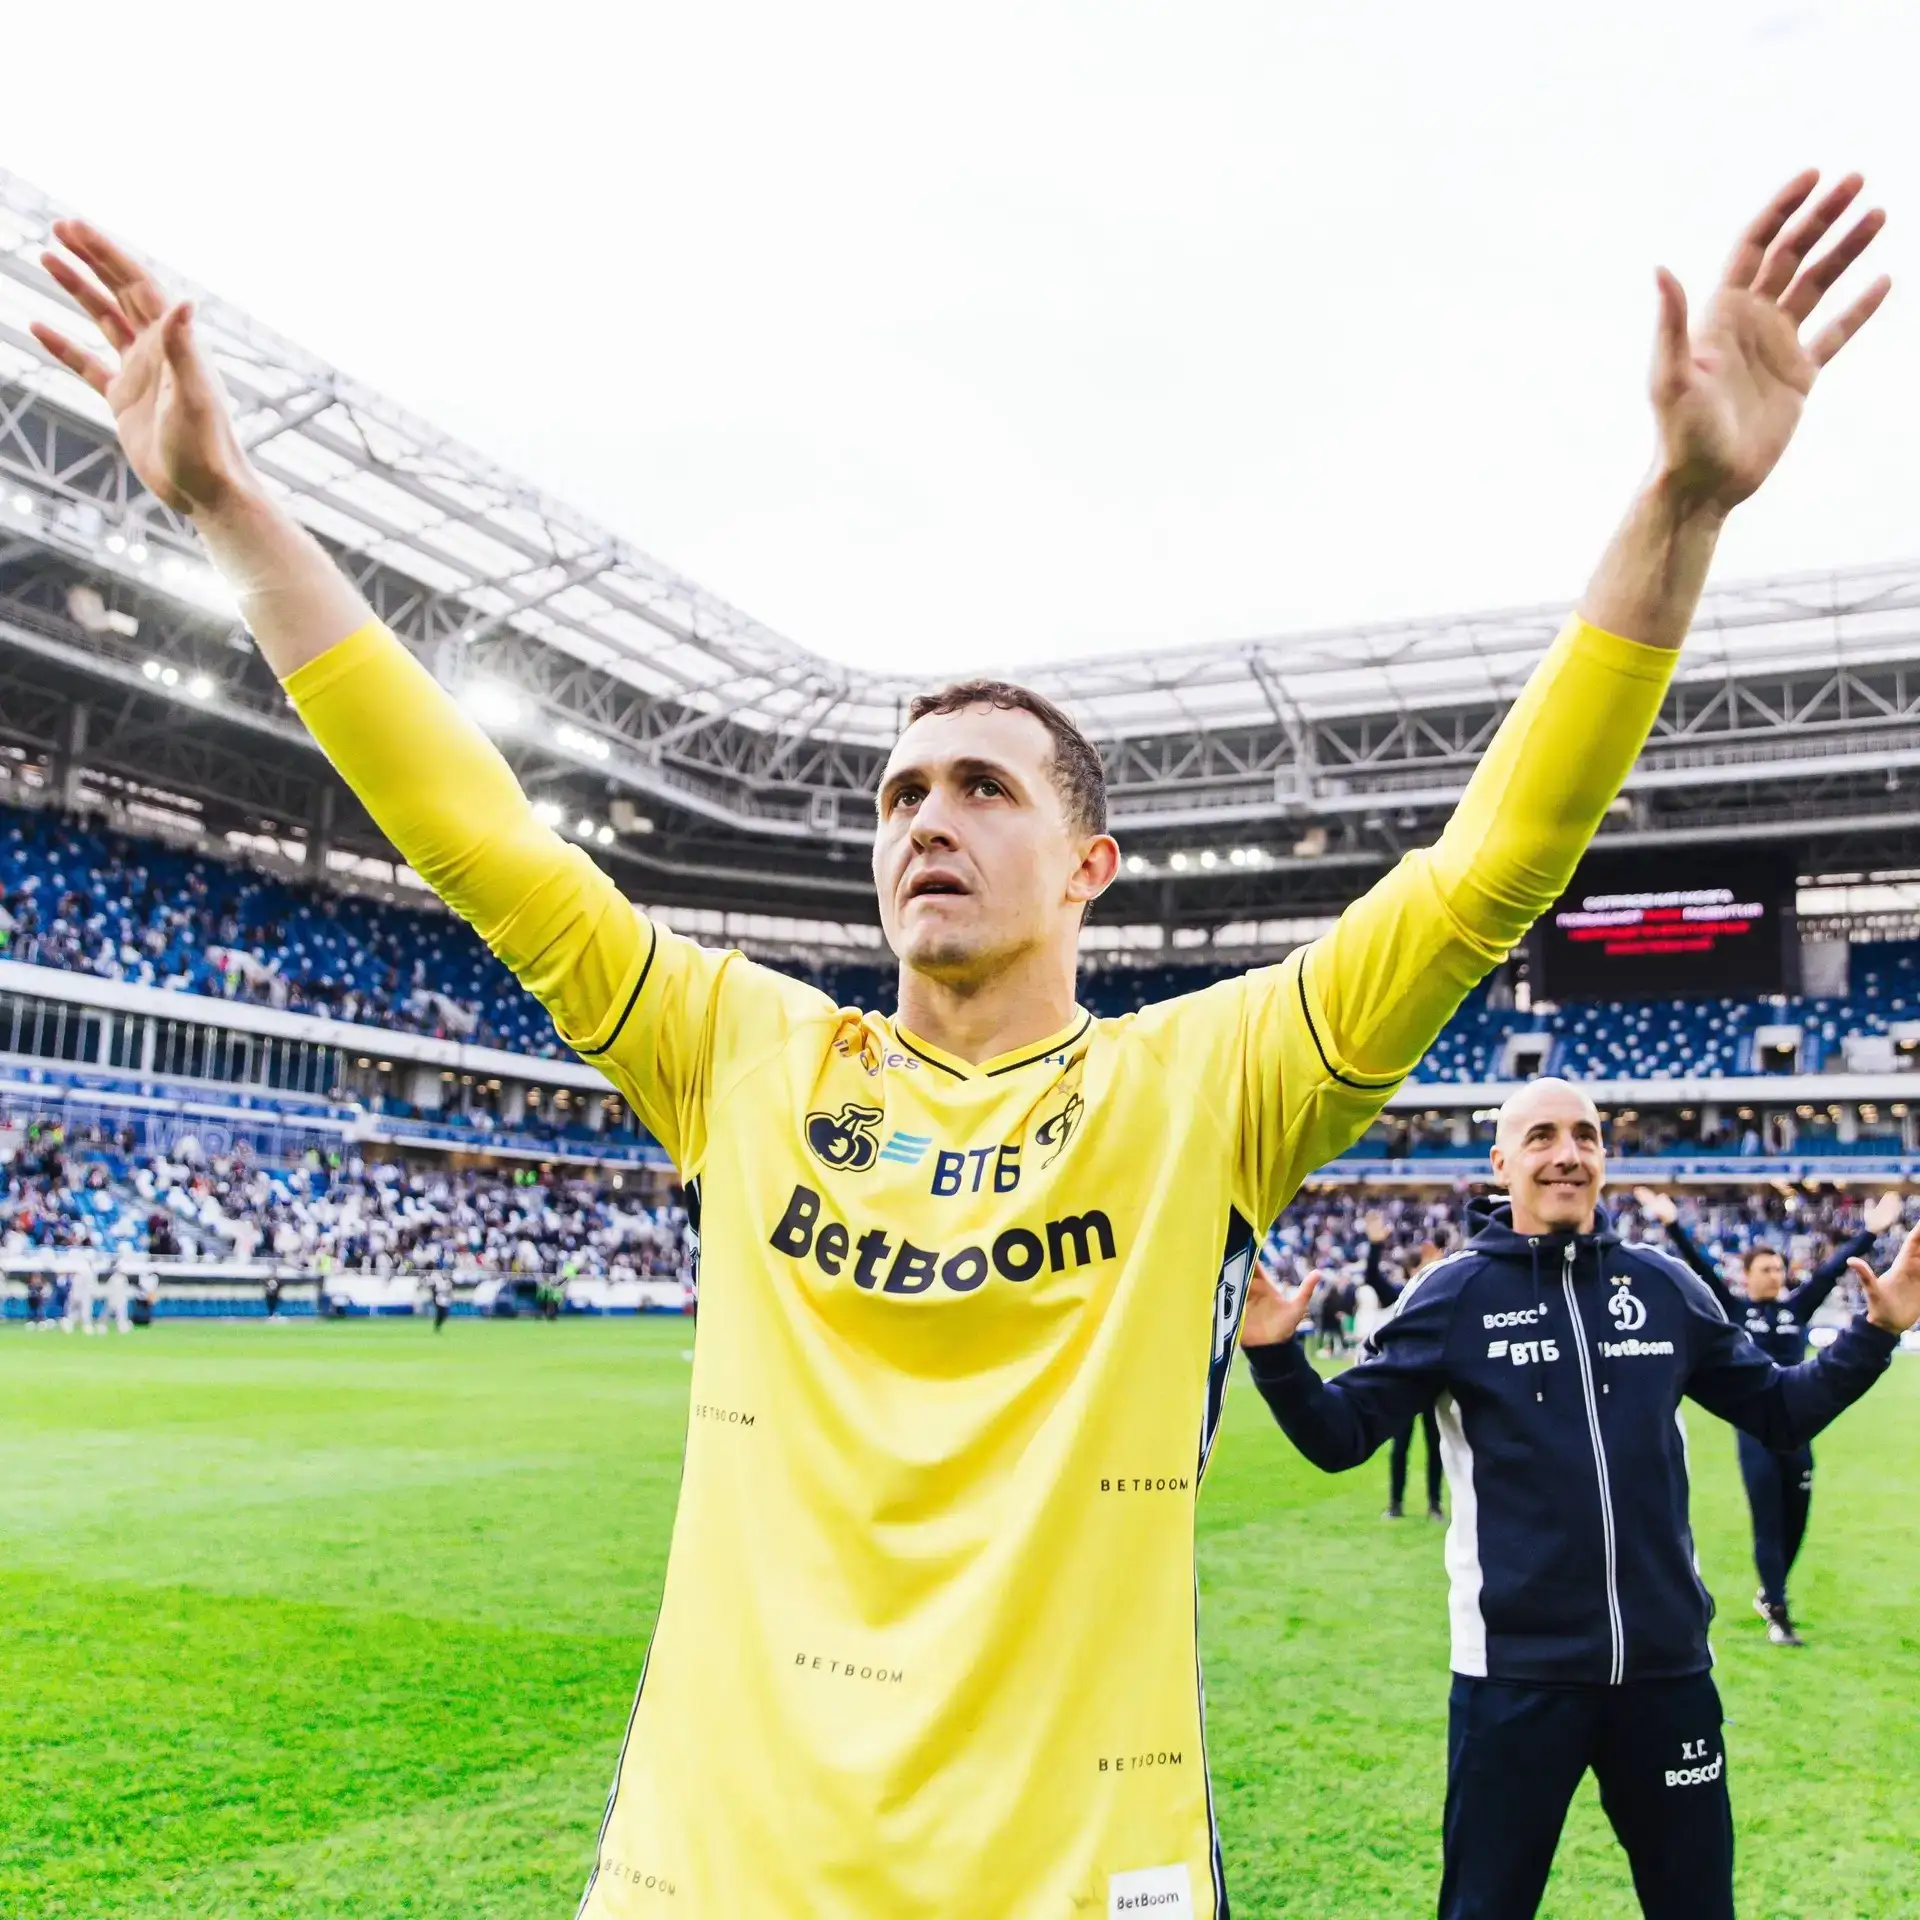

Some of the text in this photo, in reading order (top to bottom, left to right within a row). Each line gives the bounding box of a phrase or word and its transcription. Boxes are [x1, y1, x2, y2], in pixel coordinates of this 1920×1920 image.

[931, 1144, 1021, 1197] ВТБ
[769, 1184, 1117, 1294] BetBoom
[1509, 1339, 1560, 1366] ВТБ
[1100, 1478, 1188, 1492] BETBOOM
[795, 1652, 903, 1684] BETBOOM
[1664, 1762, 1721, 1787] BOSCO
[603, 1858, 676, 1897] BETBOOM
[1117, 1891, 1180, 1910] BetBoom
